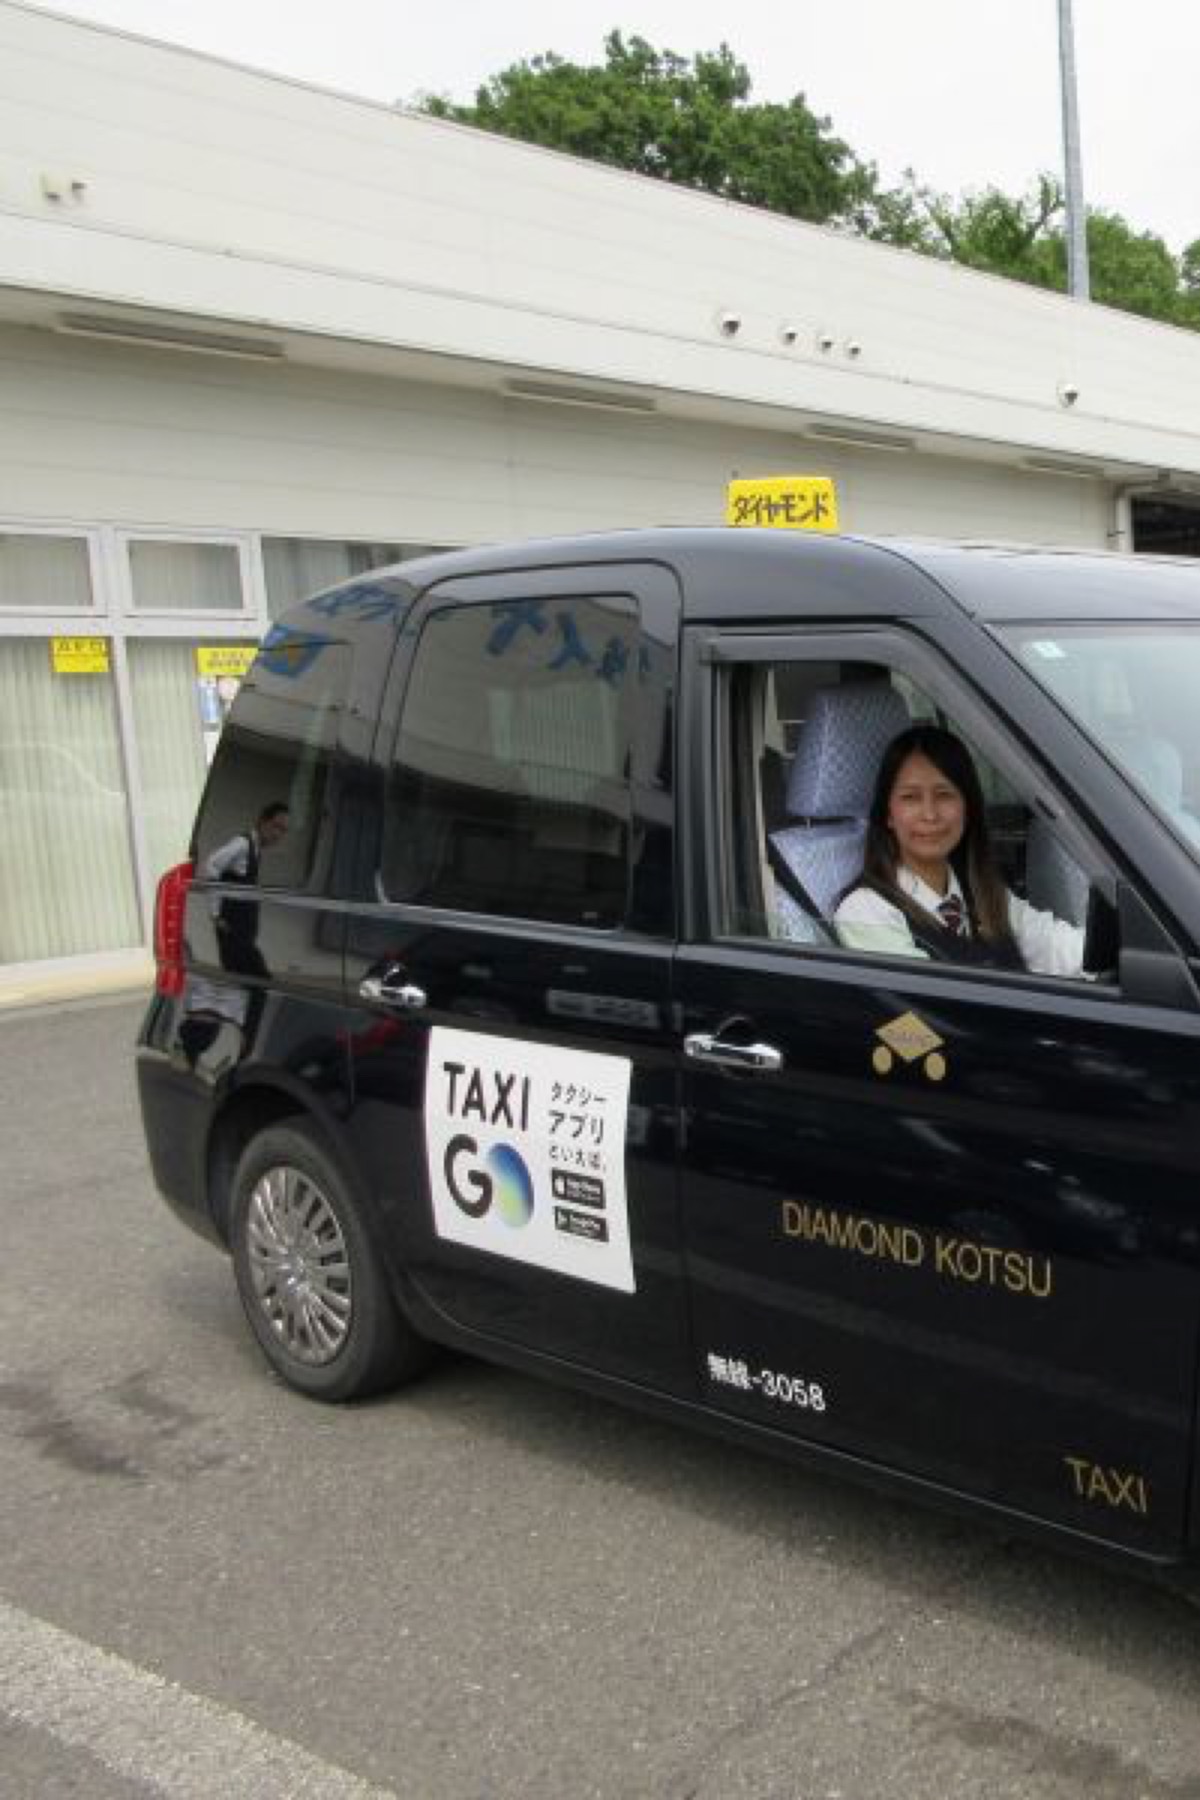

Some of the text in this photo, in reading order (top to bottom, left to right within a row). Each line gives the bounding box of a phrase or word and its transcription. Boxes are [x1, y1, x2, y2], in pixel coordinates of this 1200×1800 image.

[733, 491, 829, 527] ダイヤモンド
[443, 1061, 531, 1132] TAXI
[551, 1082, 607, 1106] タクシー
[549, 1110, 604, 1145] アプリ
[782, 1200, 1052, 1297] DIAMOND KOTSU
[1062, 1457, 1147, 1513] TAXI
